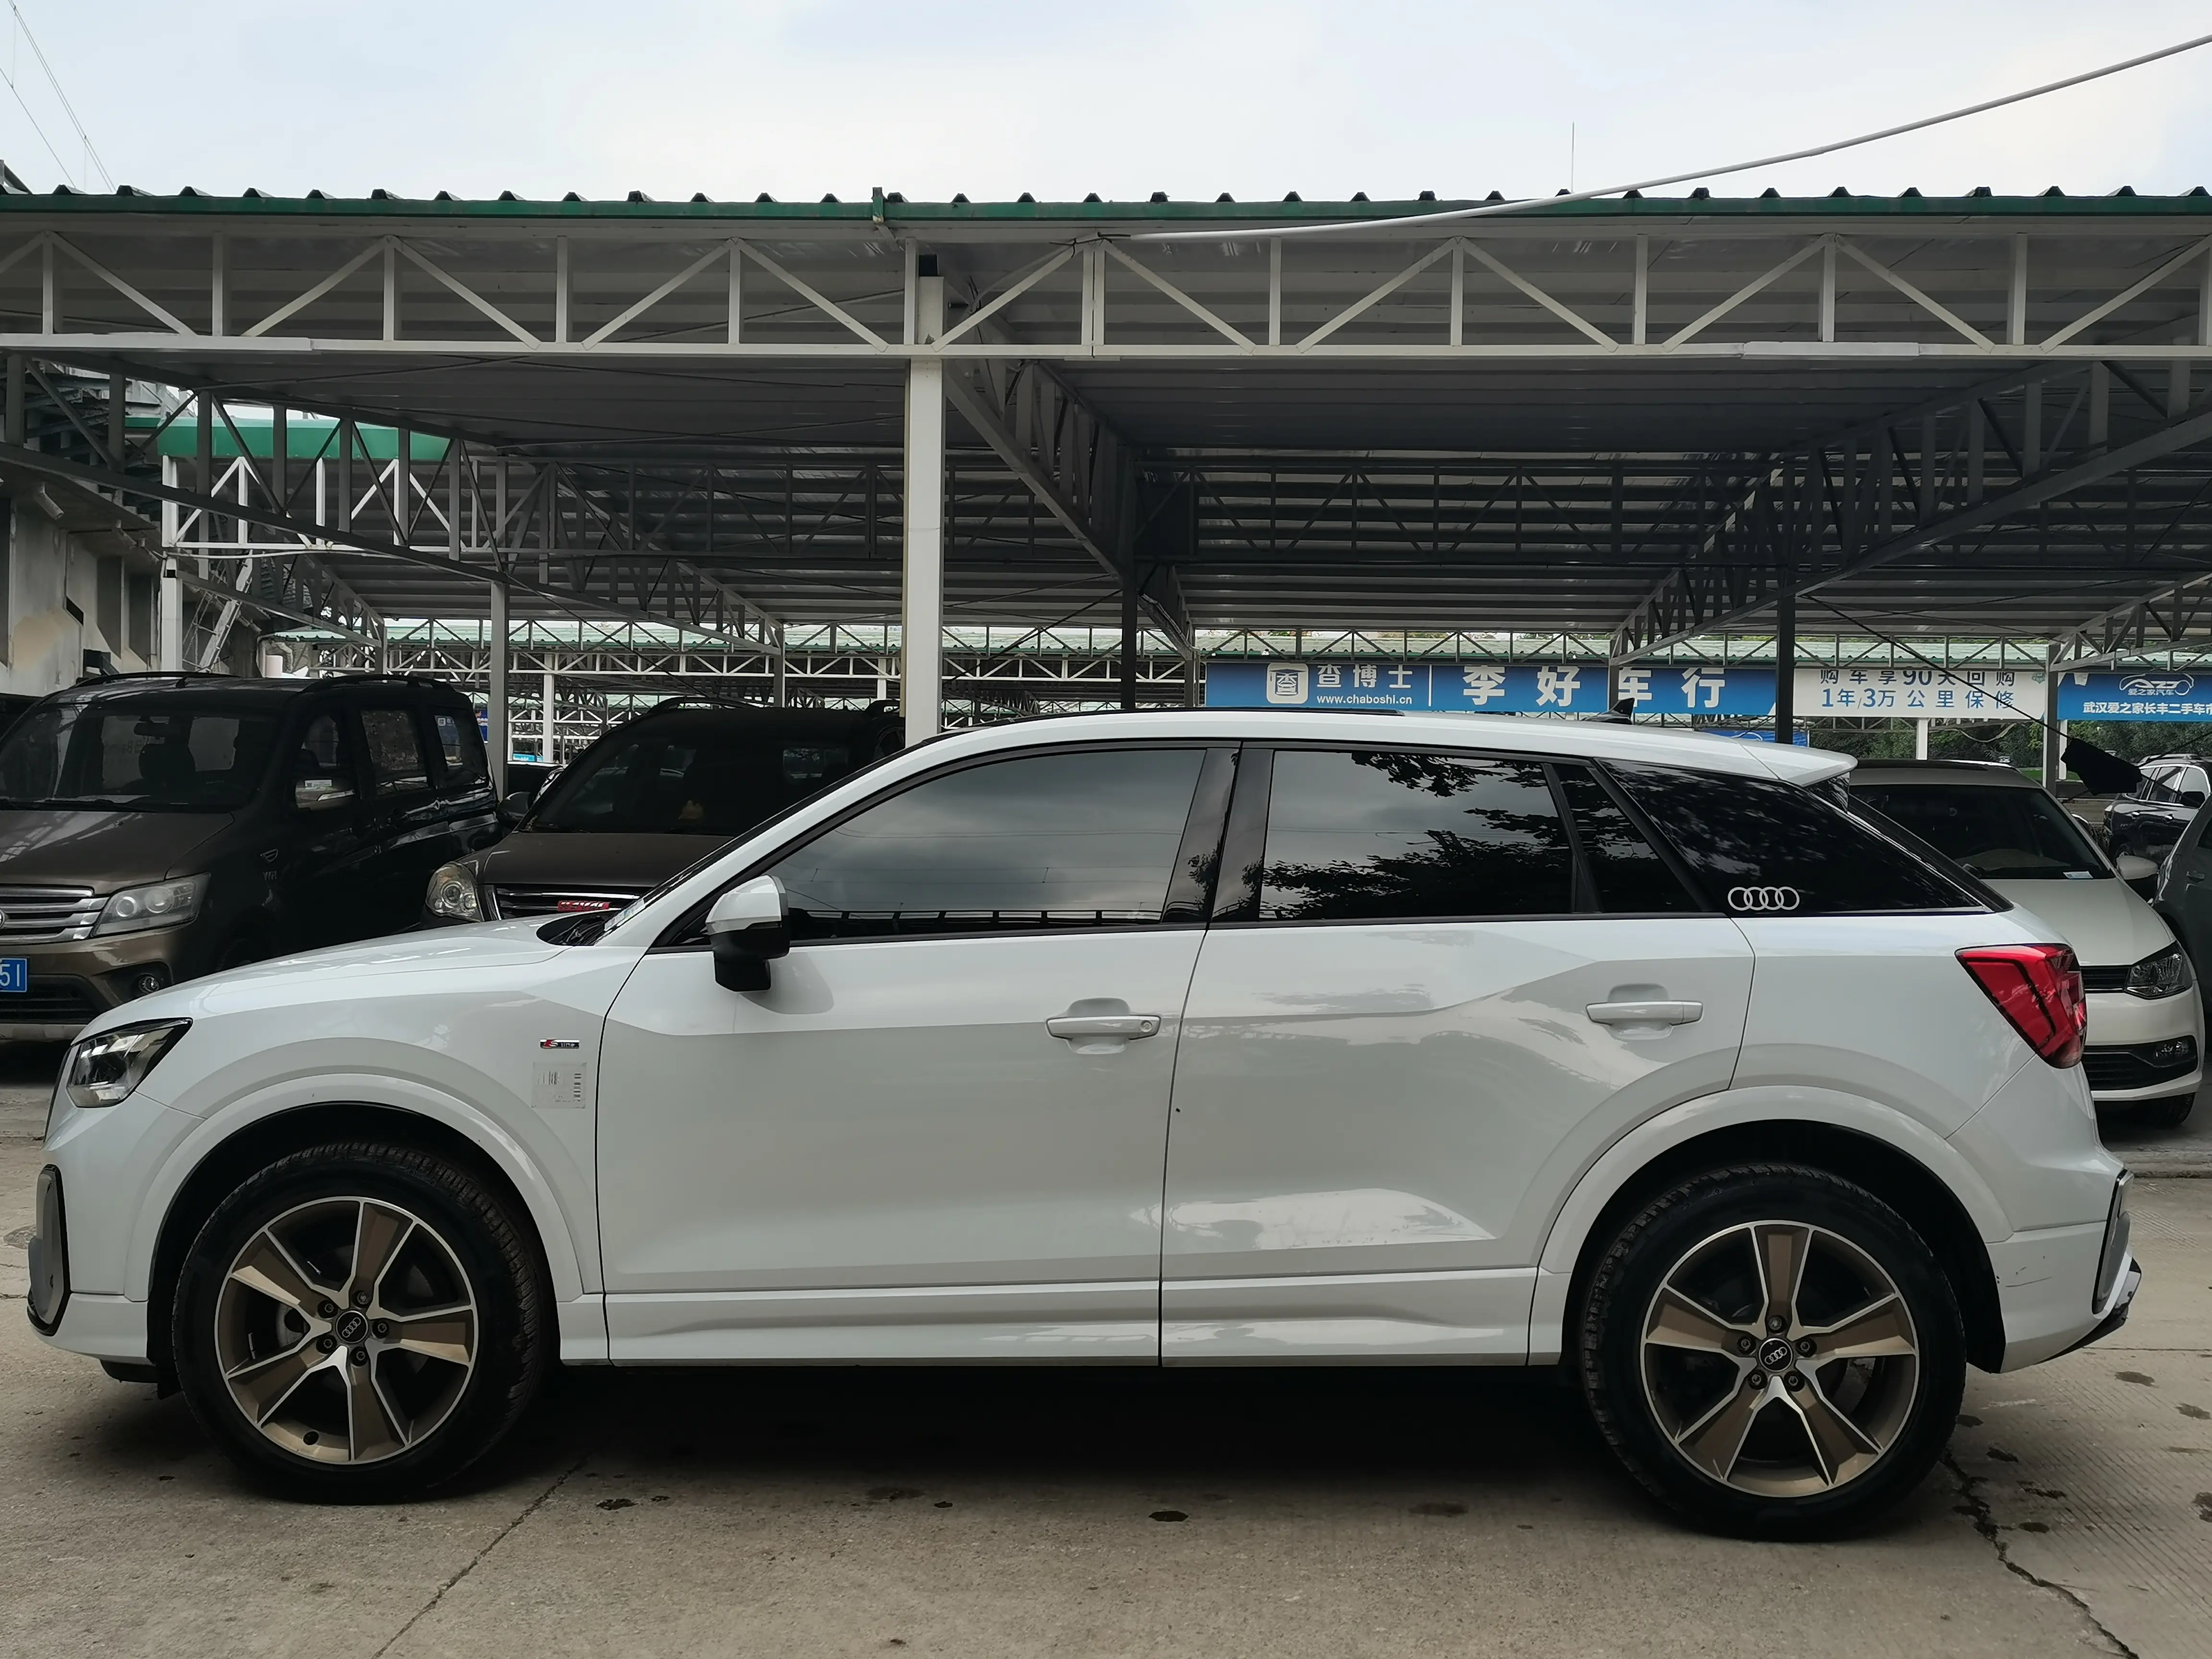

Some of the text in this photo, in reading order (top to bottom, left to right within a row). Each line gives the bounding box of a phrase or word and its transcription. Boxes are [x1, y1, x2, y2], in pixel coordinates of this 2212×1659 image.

[1317, 664, 1413, 688] 查博士
[1463, 665, 1725, 708] 李好车行
[1820, 669, 2015, 685] 购车享90天回购
[1316, 694, 1413, 705] www.chaboshi.cn
[1821, 687, 2015, 709] 1年/3万公里保修
